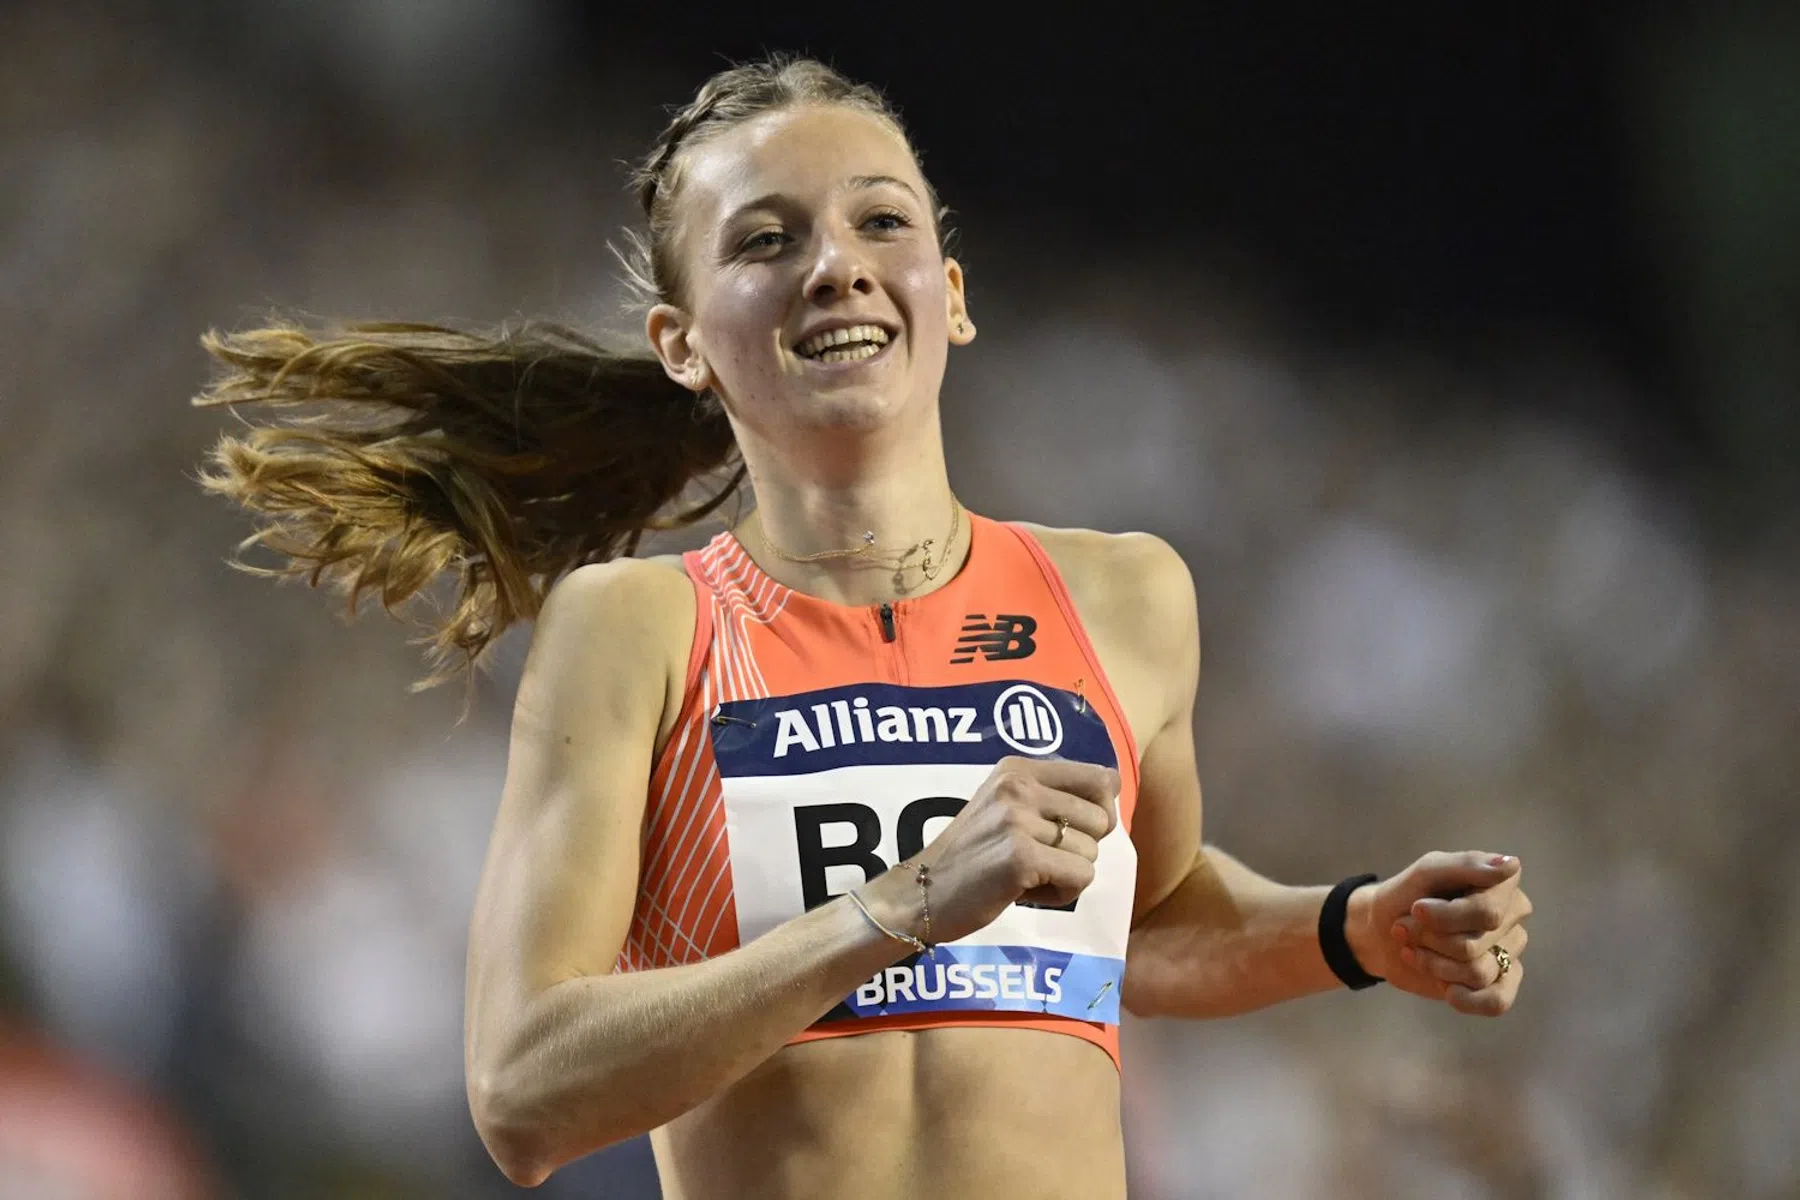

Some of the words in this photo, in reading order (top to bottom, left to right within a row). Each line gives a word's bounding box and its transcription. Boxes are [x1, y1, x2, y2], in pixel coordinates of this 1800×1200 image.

[950, 614, 1037, 664] NB
[773, 697, 982, 758] Allianz
[857, 963, 1062, 1006] BRUSSELS
